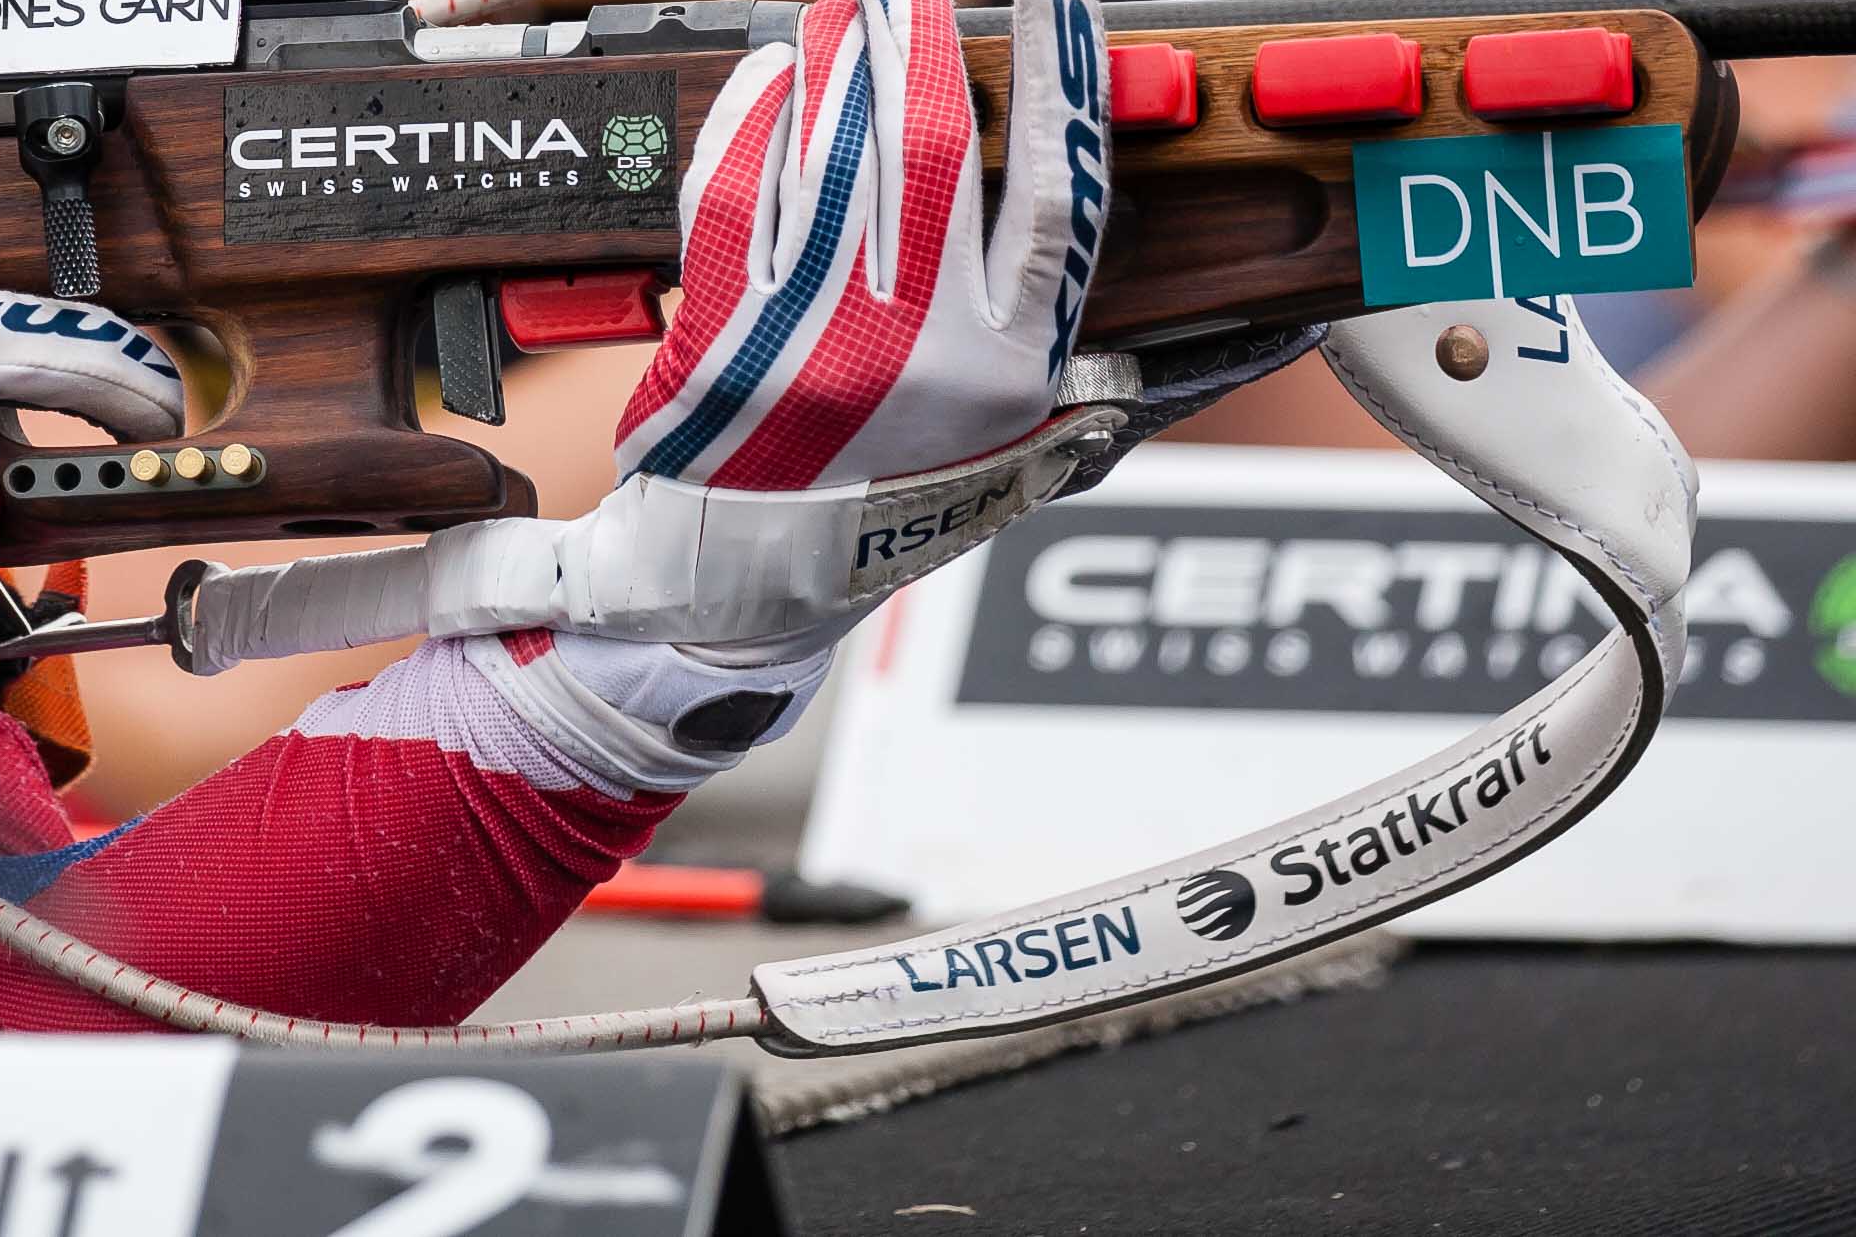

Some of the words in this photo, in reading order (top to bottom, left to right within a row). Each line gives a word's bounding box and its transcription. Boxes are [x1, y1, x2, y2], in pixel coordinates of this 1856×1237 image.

[230, 118, 589, 170] CERTINA
[617, 156, 653, 169] DS
[239, 178, 364, 198] SWISS
[392, 170, 579, 192] WATCHES
[1400, 132, 1643, 298] DNB
[896, 906, 1142, 992] LARSEN
[1270, 722, 1552, 905] Statkraft
